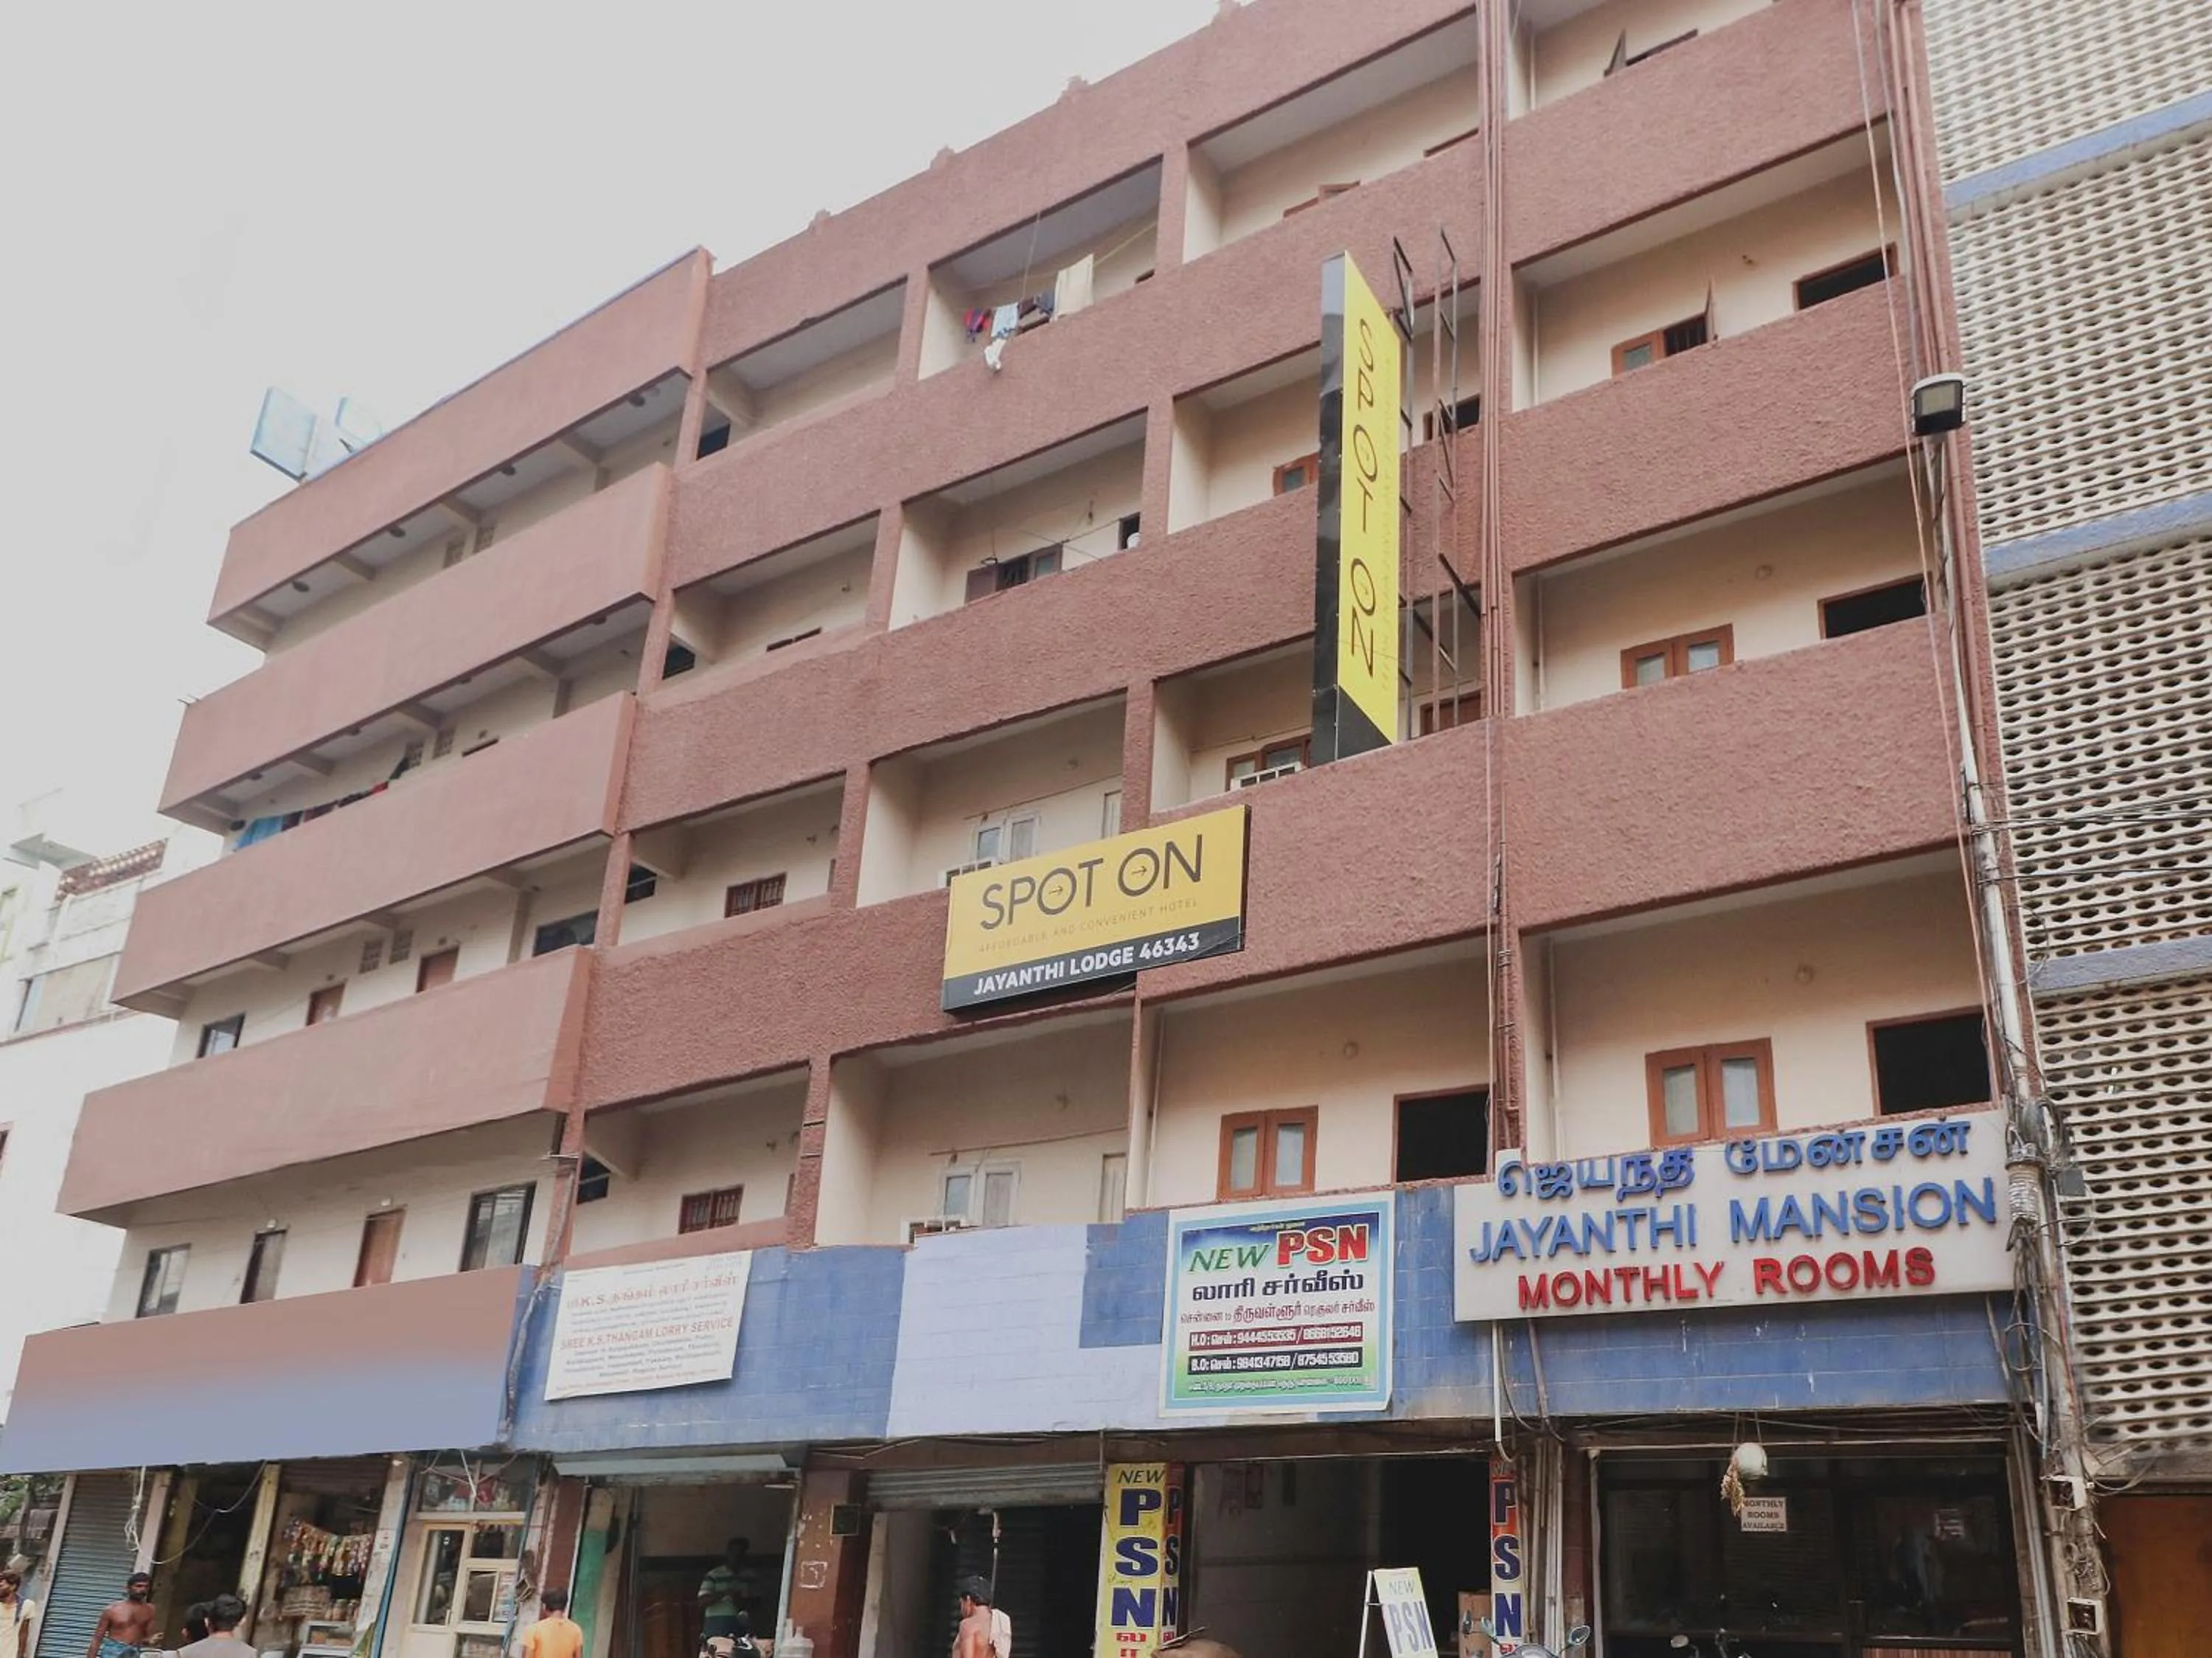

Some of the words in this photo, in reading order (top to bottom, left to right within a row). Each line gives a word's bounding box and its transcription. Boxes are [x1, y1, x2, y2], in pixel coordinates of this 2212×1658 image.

[980, 858, 1104, 930] SPOT
[1117, 834, 1203, 897] ON
[978, 932, 1046, 954] AFFORDABLE
[1054, 925, 1076, 936] AND
[1079, 907, 1155, 932] CONVENIENT
[1159, 898, 1199, 914] HOTEL
[973, 960, 1065, 996] JAYANTHI
[1069, 946, 1135, 976] LODGE
[1138, 932, 1200, 960] 46343
[1470, 1202, 1697, 1264] JAYANTHI
[1730, 1176, 1997, 1244] MANSION
[1189, 1244, 1273, 1272] NEW
[1276, 1224, 1369, 1269] PSN
[1192, 1277, 1256, 1302] லாரி
[1262, 1269, 1364, 1297] சர்வீஸ்
[1517, 1260, 1725, 1311] MONTHLY
[1753, 1246, 1937, 1296] ROOMS
[690, 1317, 734, 1333] SERVICE
[1117, 1469, 1165, 1485] NEW
[1111, 1488, 1162, 1628] PSN
[1388, 1579, 1416, 1595] NEW
[1388, 1600, 1433, 1654] PSN
